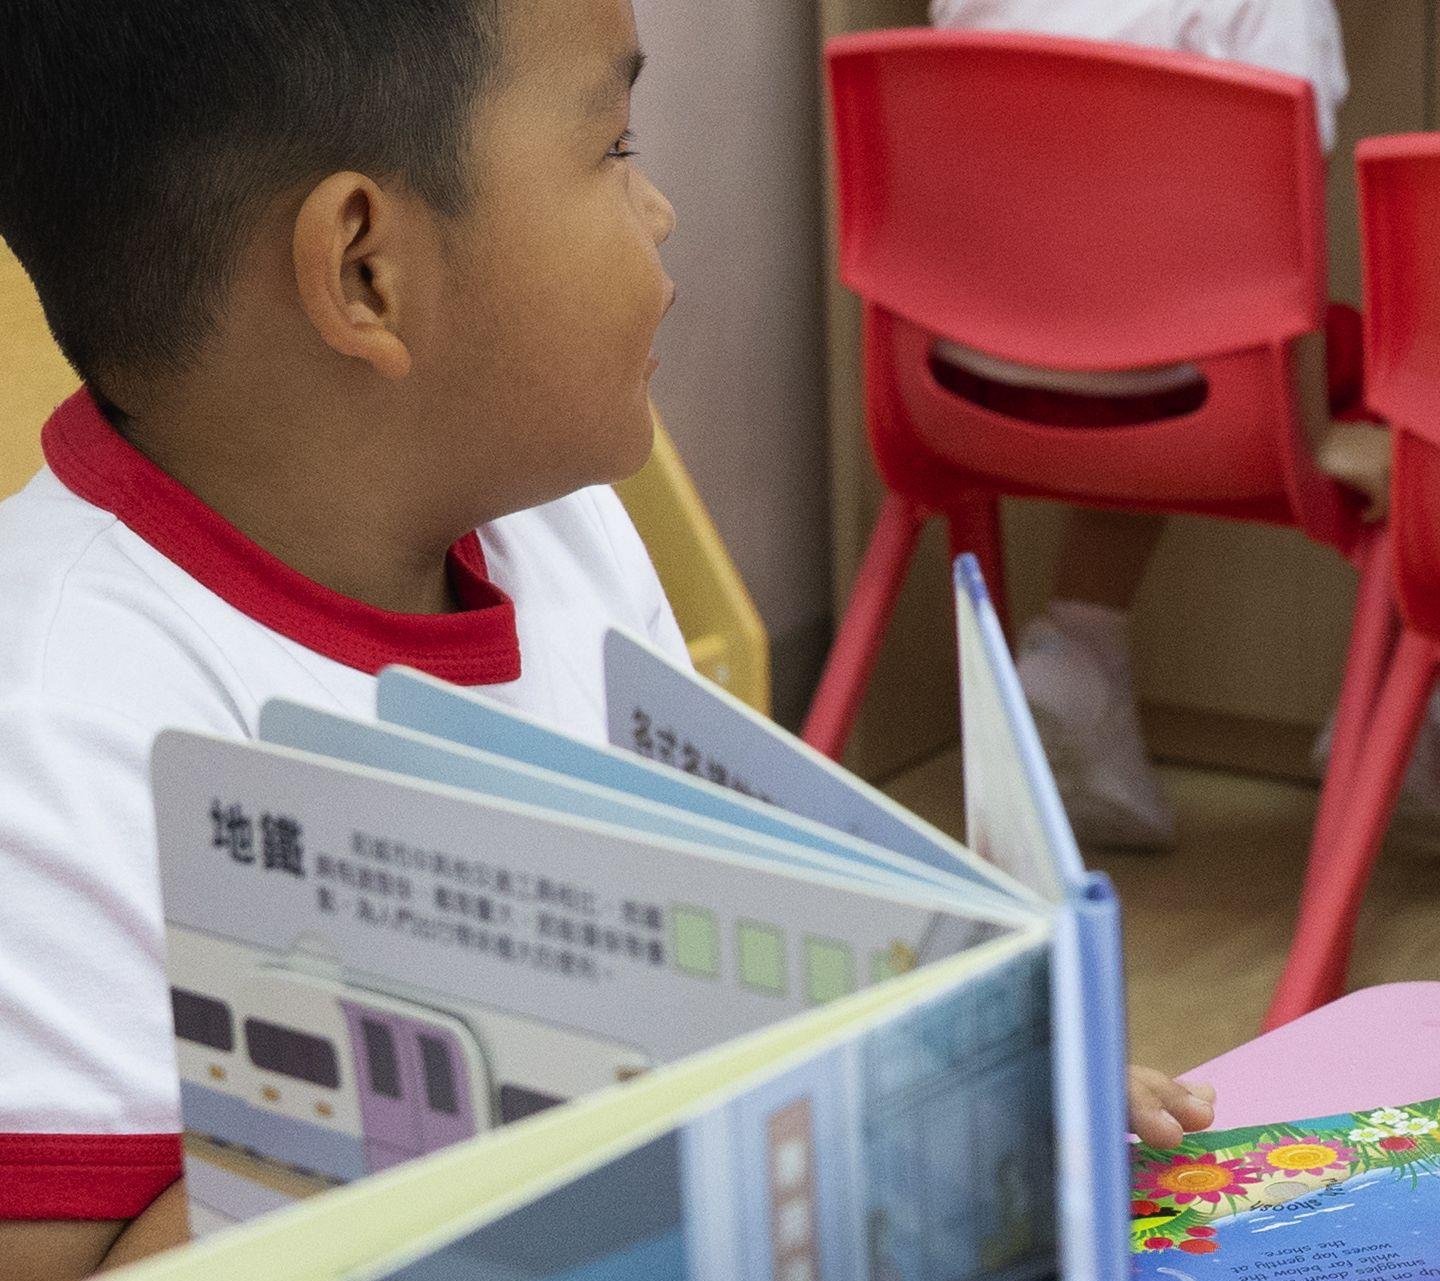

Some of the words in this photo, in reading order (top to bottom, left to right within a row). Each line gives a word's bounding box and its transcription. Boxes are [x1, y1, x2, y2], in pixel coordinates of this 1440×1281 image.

[632, 705, 773, 803] 各式各樣
[1317, 1239, 1346, 1250] the
[1342, 1242, 1392, 1255] waves
[1255, 1255, 1305, 1270] gently
[1312, 1251, 1338, 1262] lap
[1358, 1252, 1399, 1265] while
[1230, 1265, 1249, 1274] at
[1328, 1259, 1353, 1270] far
[1355, 1259, 1425, 1275] snuggles
[1274, 1264, 1320, 1278] below
[1393, 1272, 1412, 1281] on
[1420, 1267, 1440, 1278] Up
